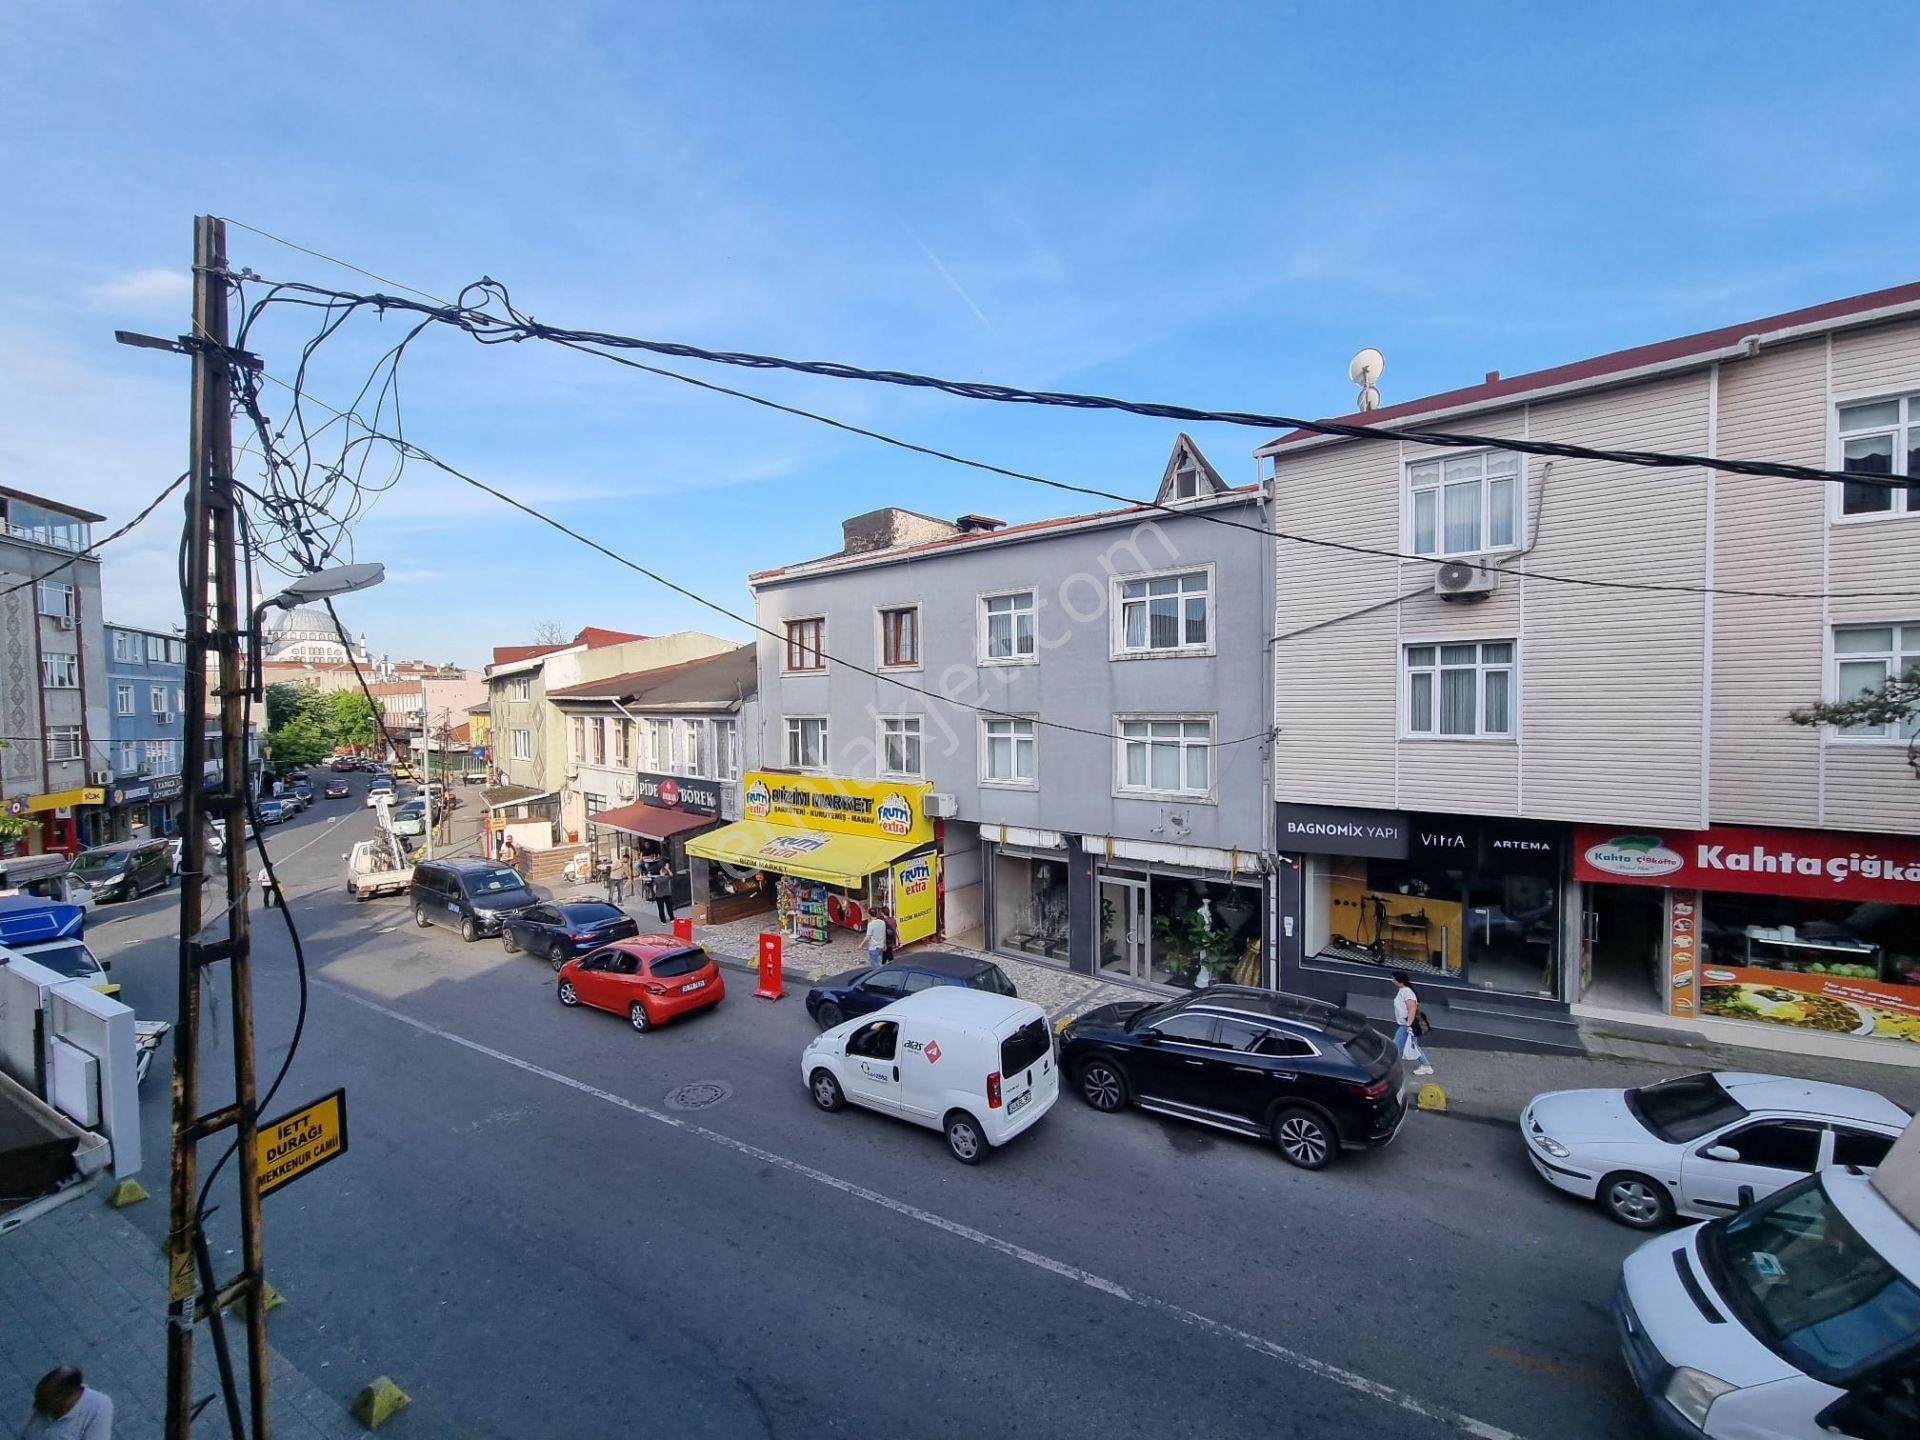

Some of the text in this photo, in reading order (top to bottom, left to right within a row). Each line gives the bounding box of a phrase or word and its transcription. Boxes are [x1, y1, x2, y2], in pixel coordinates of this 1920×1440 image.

[883, 821, 905, 833] extra
[1287, 822, 1398, 839] BAGNOMİX YAPI
[1421, 832, 1466, 848] VitrA
[1493, 840, 1550, 851] ARTEMA
[1595, 852, 1632, 863] Kahta
[905, 881, 927, 896] extra
[903, 1040, 924, 1052] aras
[258, 1151, 312, 1187] MEKKENUR
